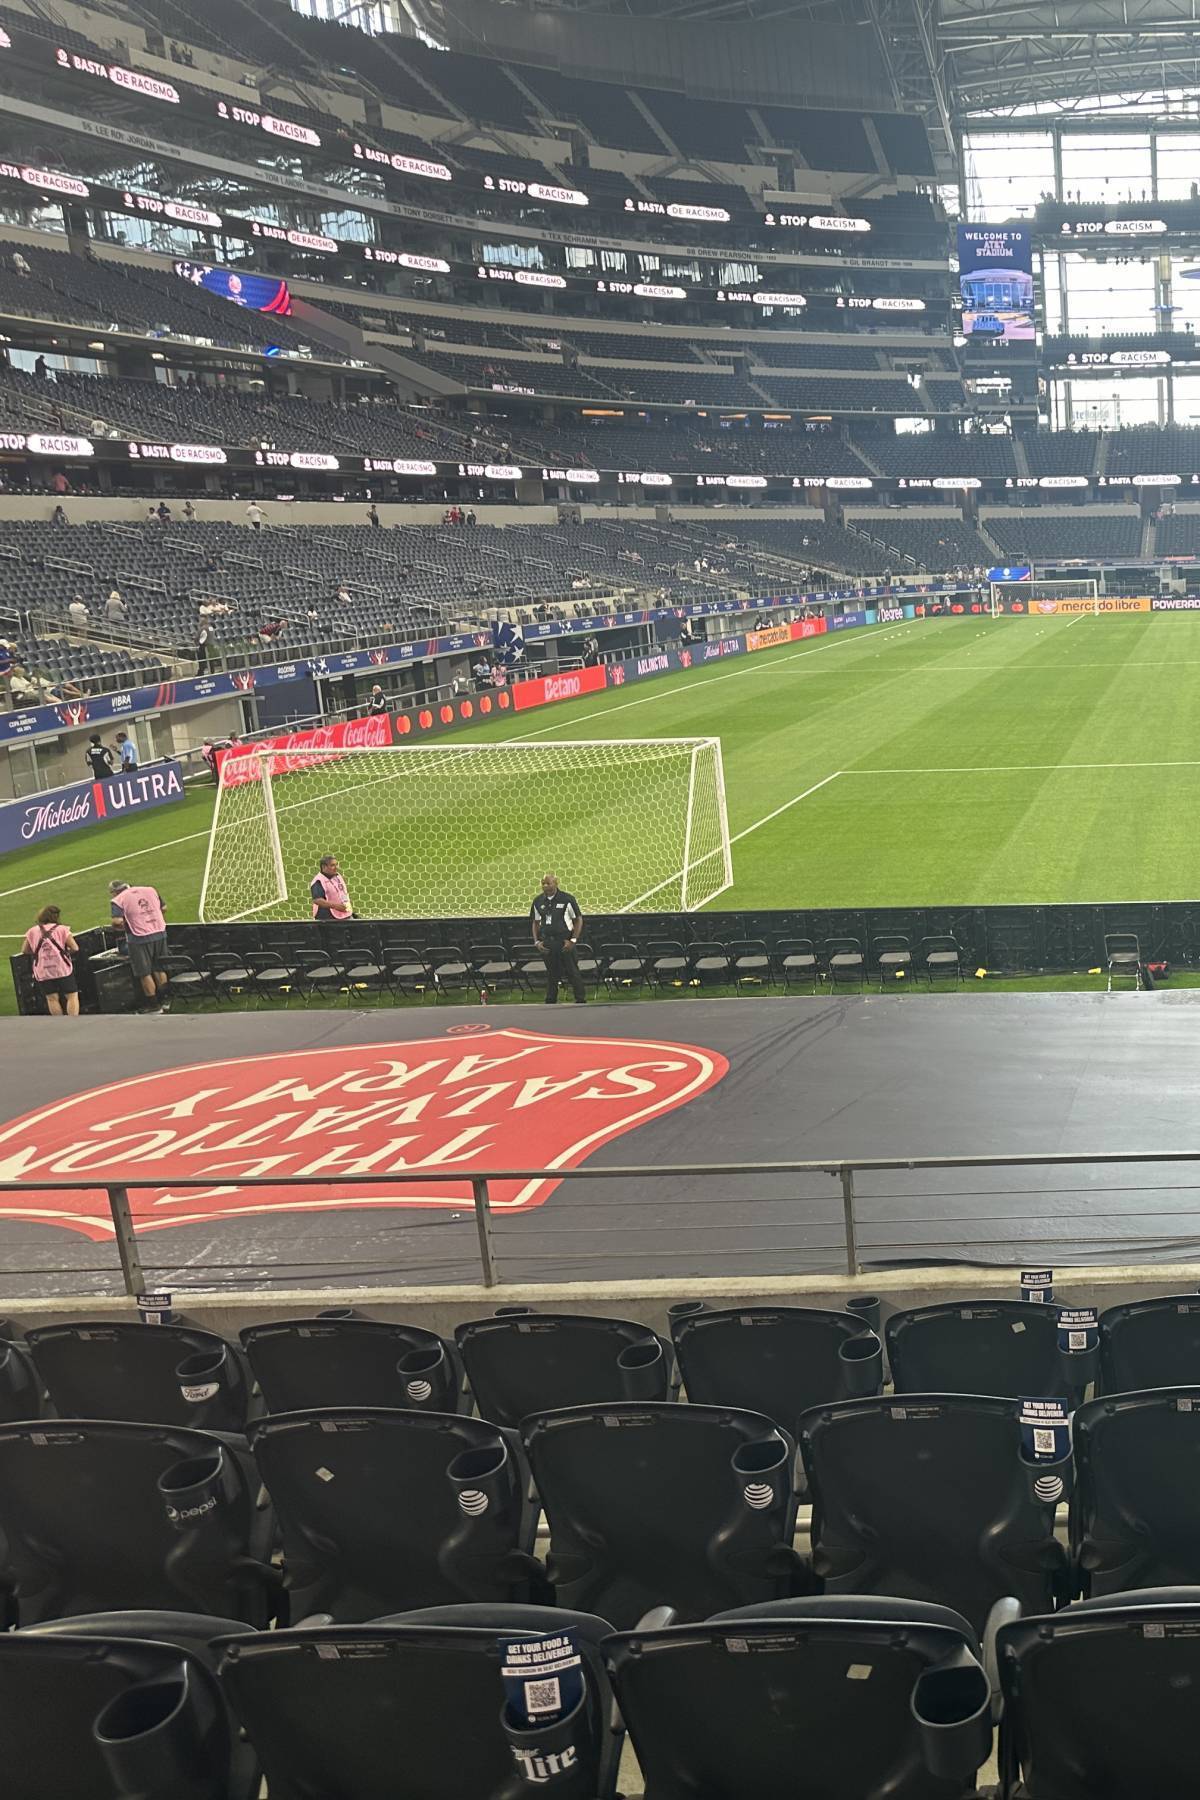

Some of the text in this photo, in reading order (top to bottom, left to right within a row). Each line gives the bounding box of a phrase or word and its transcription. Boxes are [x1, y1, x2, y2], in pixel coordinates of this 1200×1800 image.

[73, 56, 174, 98] BASTA DE RACISMO
[233, 107, 307, 140] STOP RACISM
[366, 148, 447, 176] BASTA DE RACISMO
[29, 172, 40, 183] DE
[43, 176, 84, 193] RACISMO
[499, 179, 573, 200] STOP RACISM
[137, 196, 208, 223] STOP RACISM
[638, 202, 664, 214] BASTA
[686, 208, 724, 218] RACISMO
[780, 215, 856, 228] STOP RACISM
[1076, 222, 1153, 232] STOP RACISM
[263, 226, 287, 240] BASTA
[375, 250, 438, 268] STOP RACISM
[976, 248, 1013, 257] STADIUM
[490, 269, 513, 281] BASTA
[531, 276, 561, 285] RACISMO
[610, 282, 674, 296] STOP RACISM
[849, 299, 871, 307] STOP
[1082, 353, 1157, 363] STOP RACISM
[40, 438, 78, 452] RACISM
[142, 447, 222, 460] BASTA DE RACISMO
[266, 453, 328, 466] STOP RACISM
[1017, 478, 1038, 486] STOP
[1115, 600, 1141, 610] libre
[880, 608, 903, 622] Degree
[637, 655, 668, 675] ARLINGTON
[544, 676, 580, 700] Betano
[22, 770, 182, 839] Michelob ULTRA
[89, 1044, 558, 1133] ARMY
[0, 1059, 689, 1182] SALVATION
[152, 1122, 503, 1206] THE
[180, 1496, 217, 1520] pepsi
[508, 1644, 521, 1654] GET
[523, 1642, 541, 1653] YOUR
[543, 1638, 562, 1650] FOOD
[507, 1652, 532, 1664] DRINKS
[519, 1745, 578, 1782] Lite
